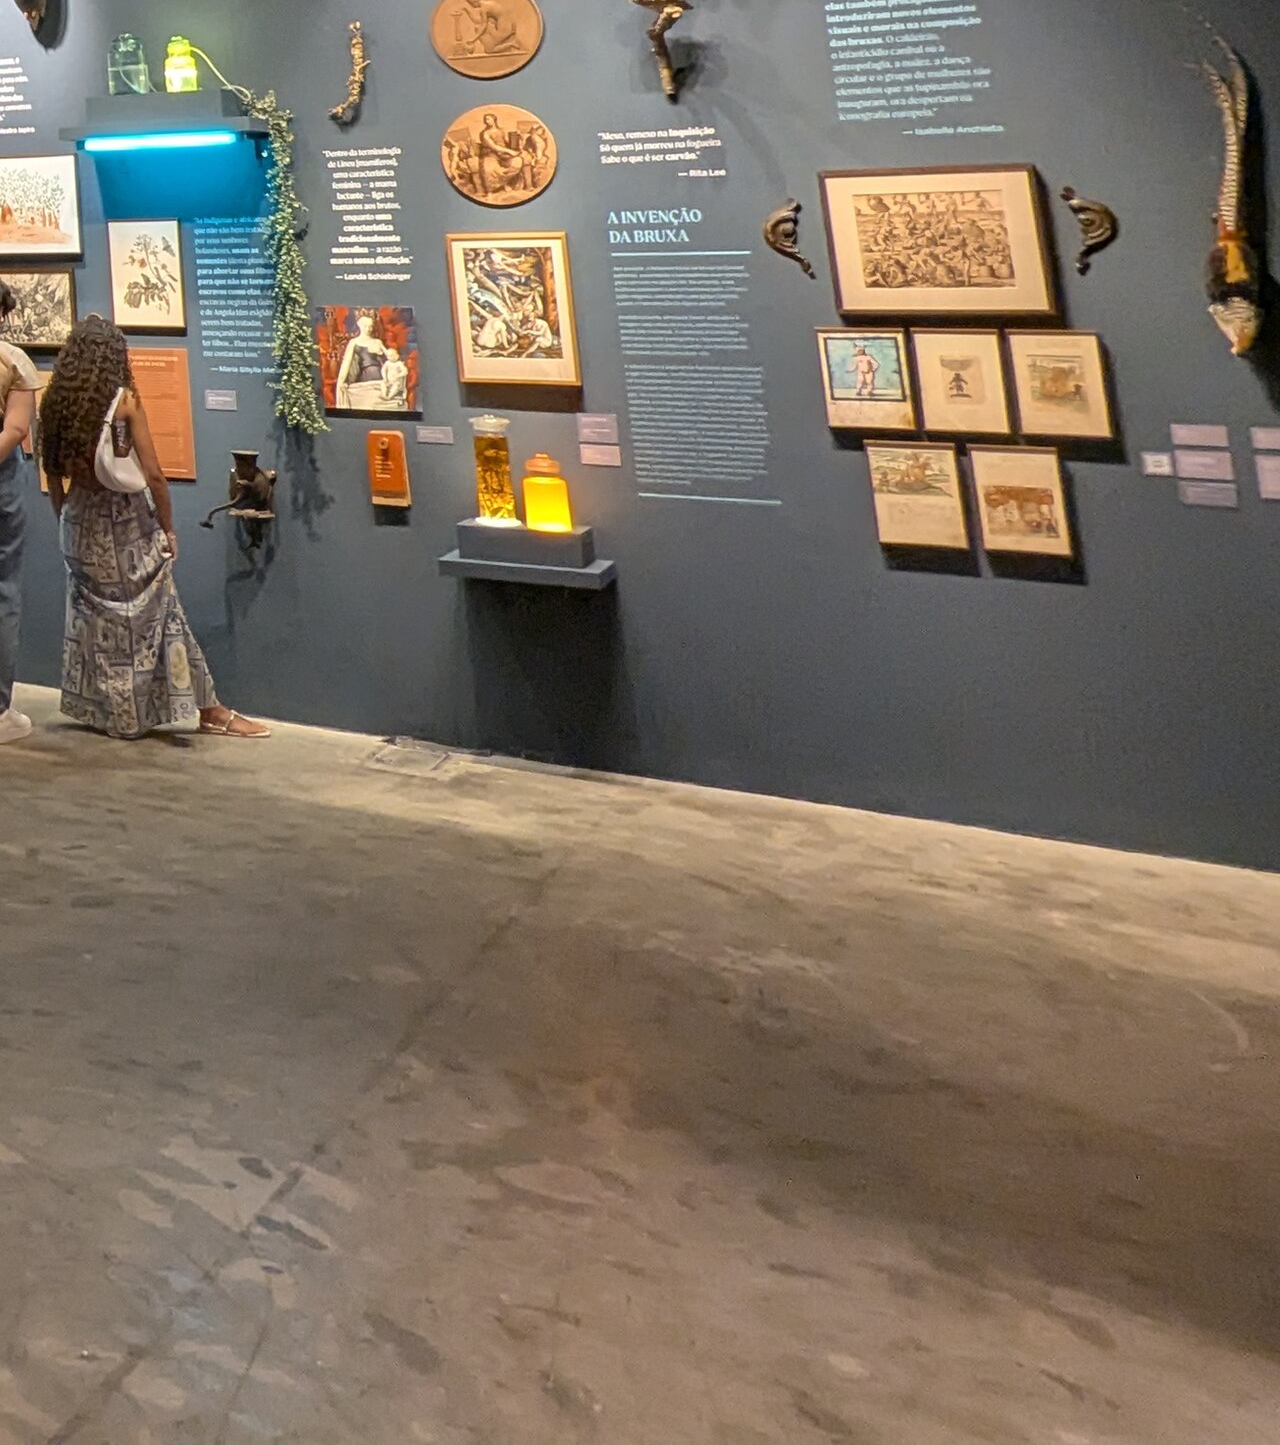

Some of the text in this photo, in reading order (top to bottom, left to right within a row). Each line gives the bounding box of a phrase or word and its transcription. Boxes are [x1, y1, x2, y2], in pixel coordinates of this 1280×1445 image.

[608, 207, 702, 226] A INVENÇÃO
[609, 229, 689, 243] DA BRUXA
